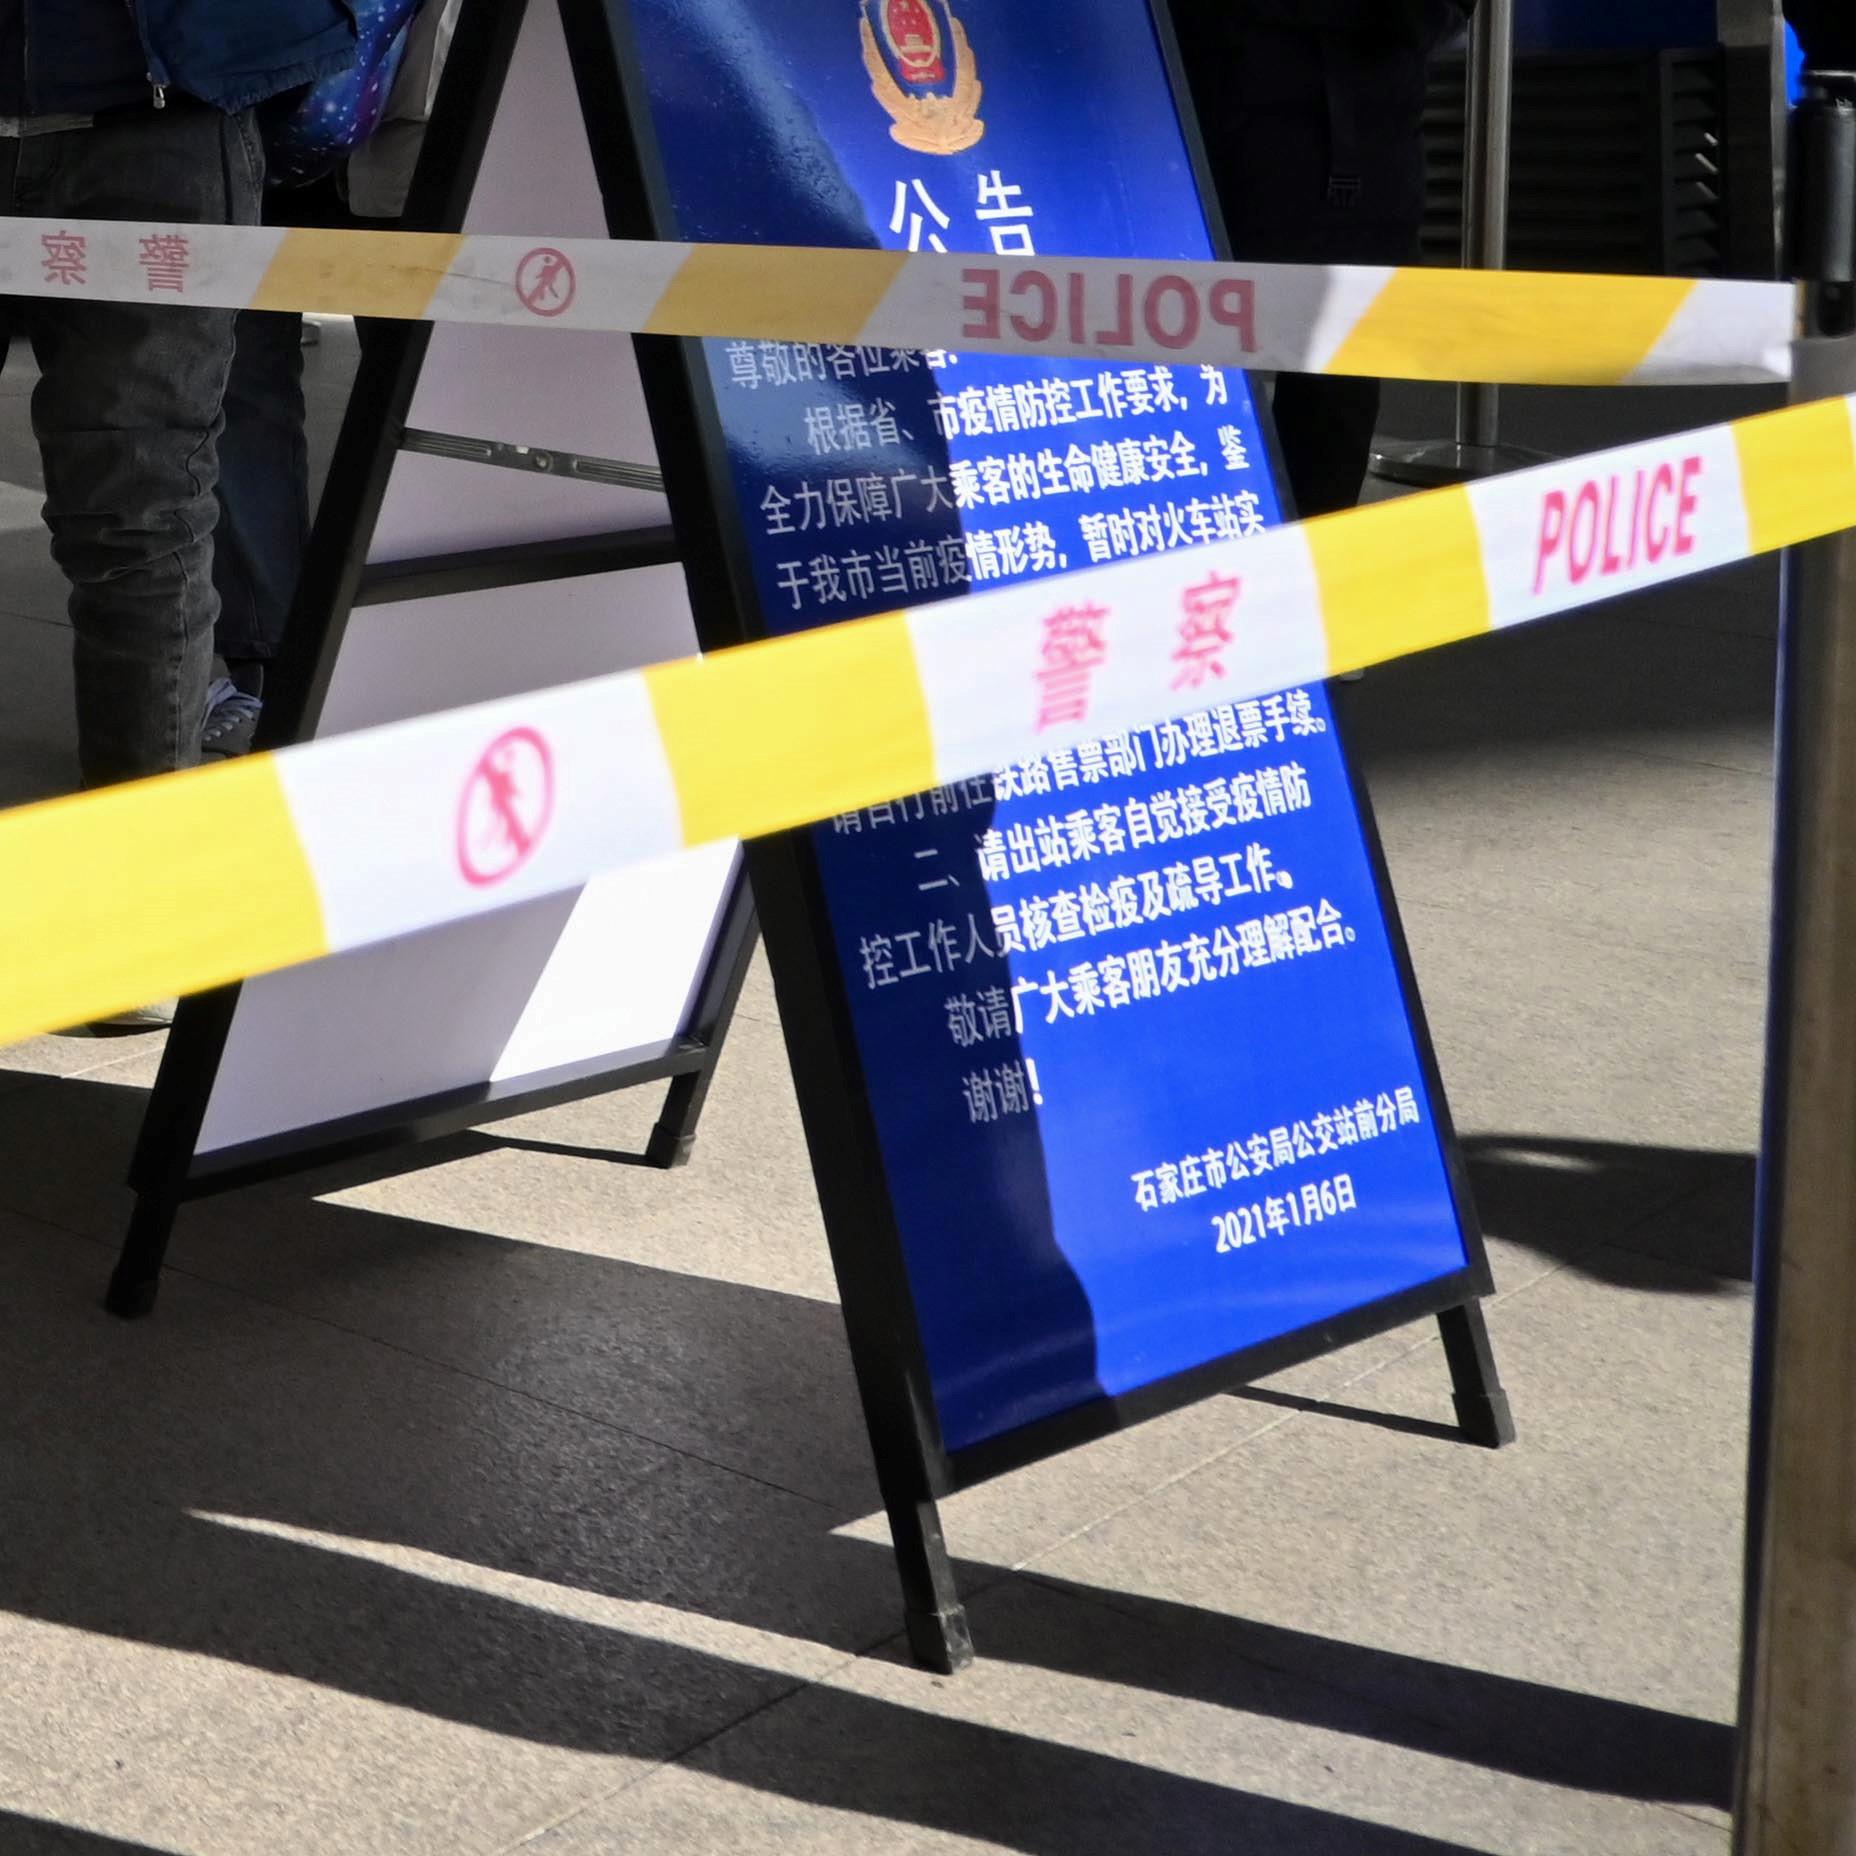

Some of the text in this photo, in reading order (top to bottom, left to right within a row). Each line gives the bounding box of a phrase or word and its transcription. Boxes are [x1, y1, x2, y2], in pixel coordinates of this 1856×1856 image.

[890, 169, 1034, 255] 公告
[1532, 455, 1704, 596] POLICE
[1033, 571, 1245, 735] 警察
[1212, 1173, 1357, 1254] 2021年1月6日
